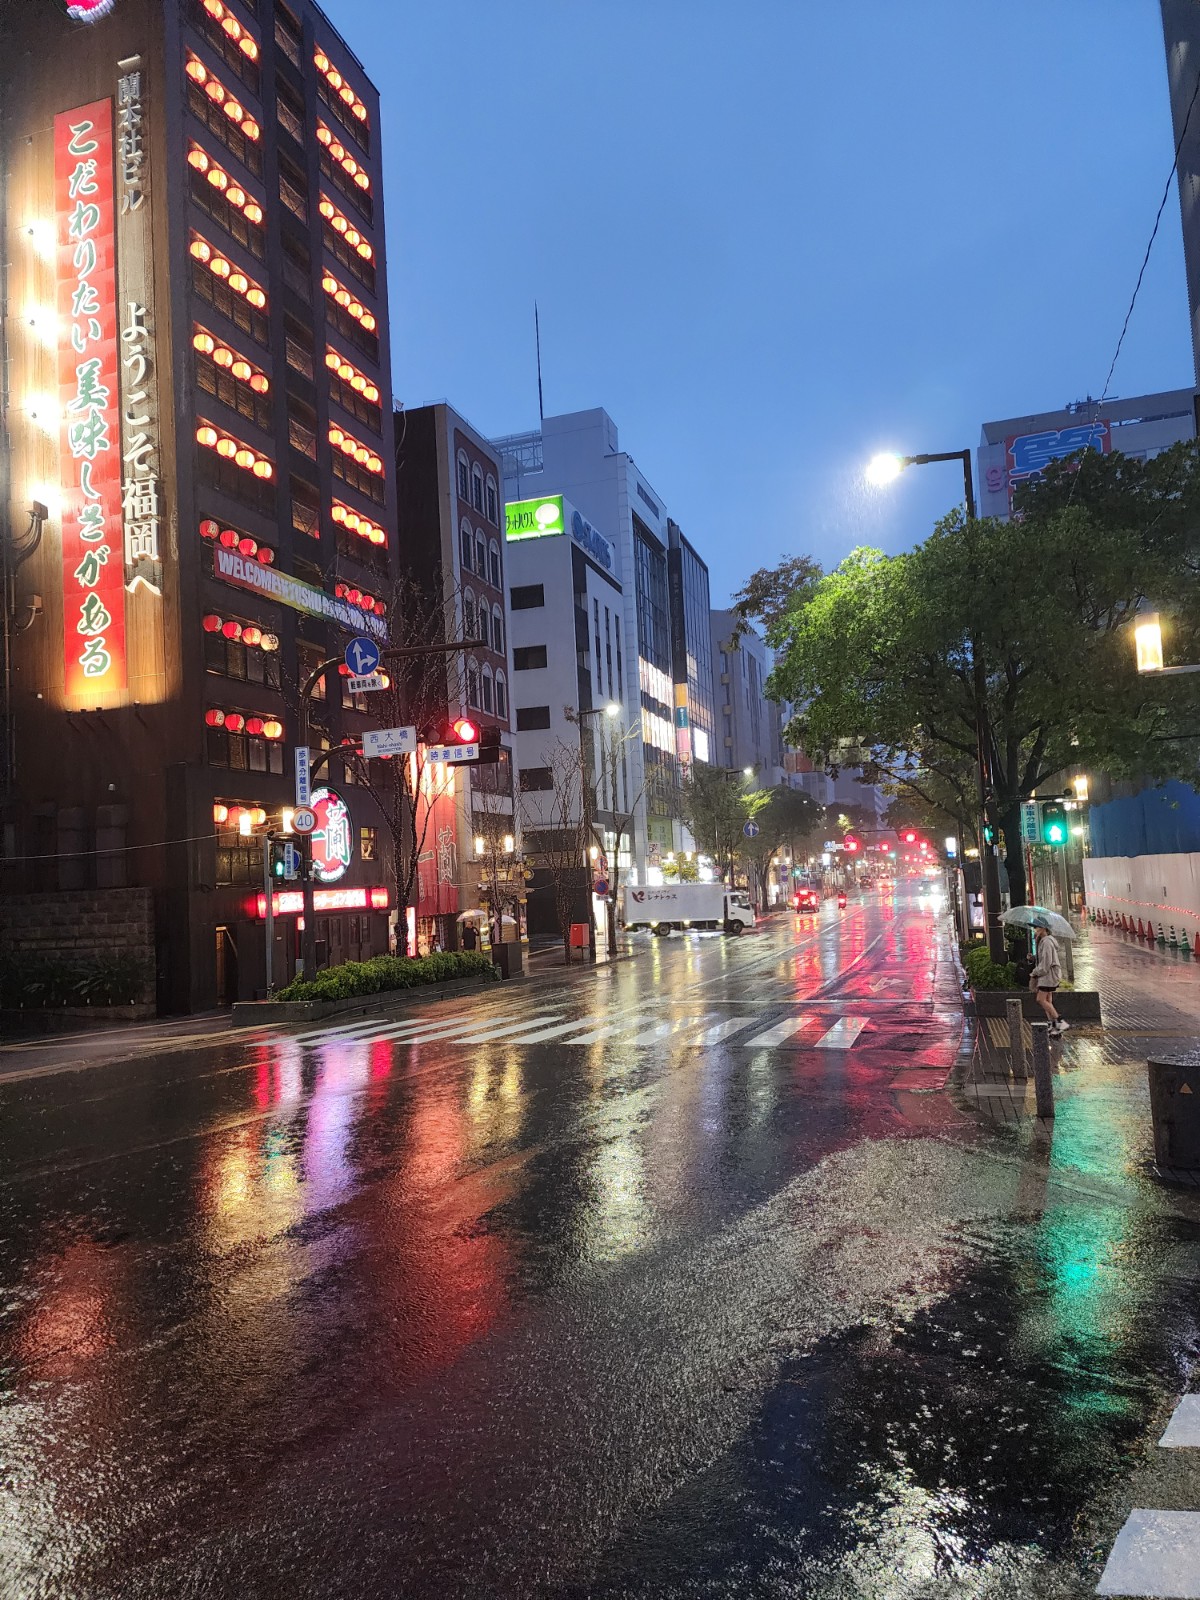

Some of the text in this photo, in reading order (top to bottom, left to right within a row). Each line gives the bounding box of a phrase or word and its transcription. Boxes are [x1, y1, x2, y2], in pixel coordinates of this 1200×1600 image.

[116, 54, 144, 216] 一蘭本社ビル
[67, 119, 112, 678] こだわりたい美味しさがある
[120, 302, 162, 597] ようこそ福岡へ
[218, 549, 281, 597] WELCOME
[370, 730, 409, 744] 西大橋
[430, 746, 475, 761] 時差信号
[297, 814, 312, 826] 40
[1026, 805, 1036, 840] 歩車分離信号
